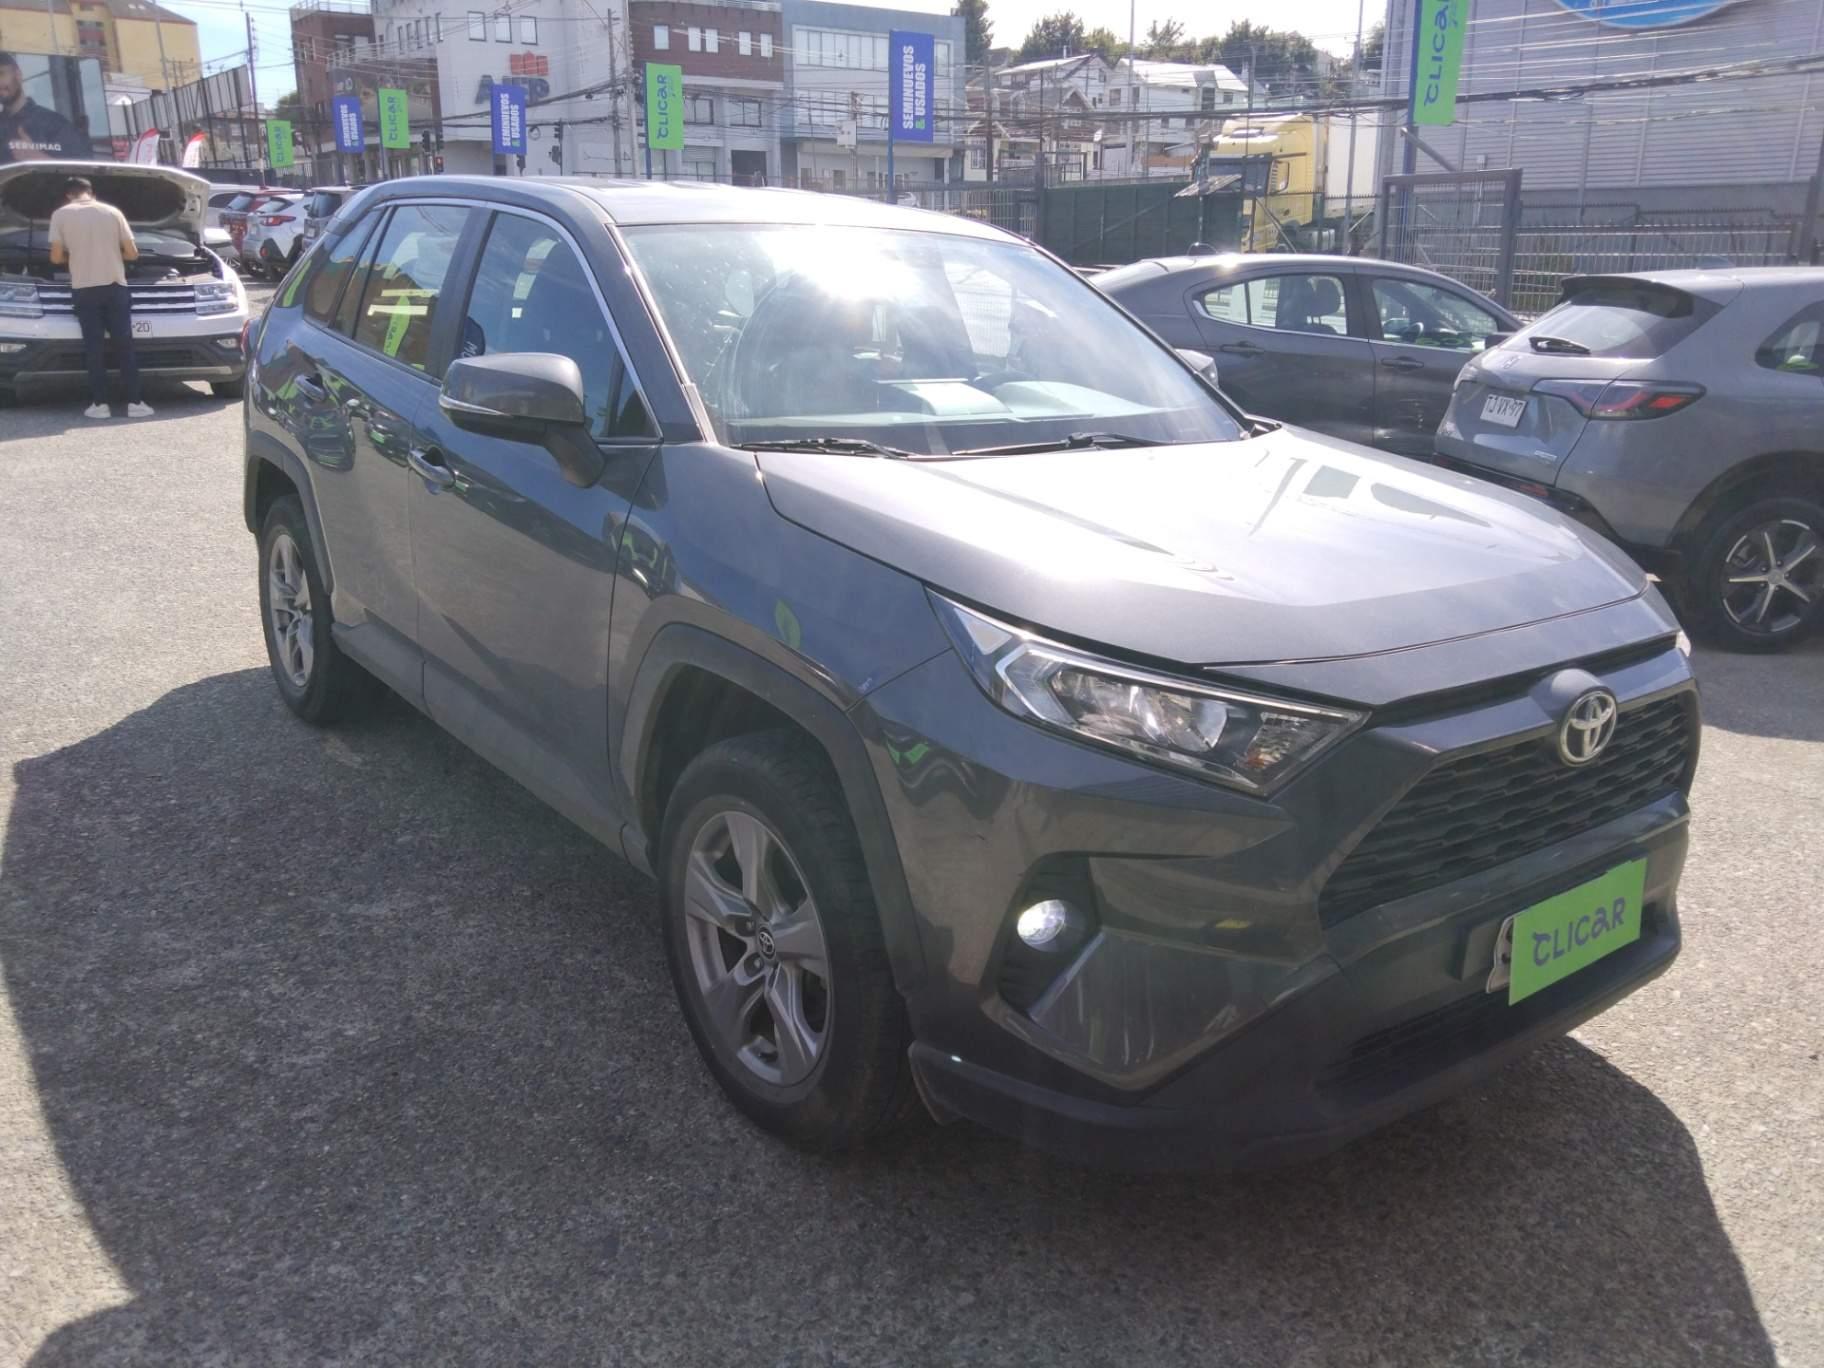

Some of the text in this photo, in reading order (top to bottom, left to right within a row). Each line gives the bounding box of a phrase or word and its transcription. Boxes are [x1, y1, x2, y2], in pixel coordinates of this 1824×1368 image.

[902, 45, 914, 130] SEMINUEVOS
[915, 63, 926, 116] USADOS
[8, 141, 63, 152] SERVIMAQ
[500, 93, 511, 147] SEMINUEVOS
